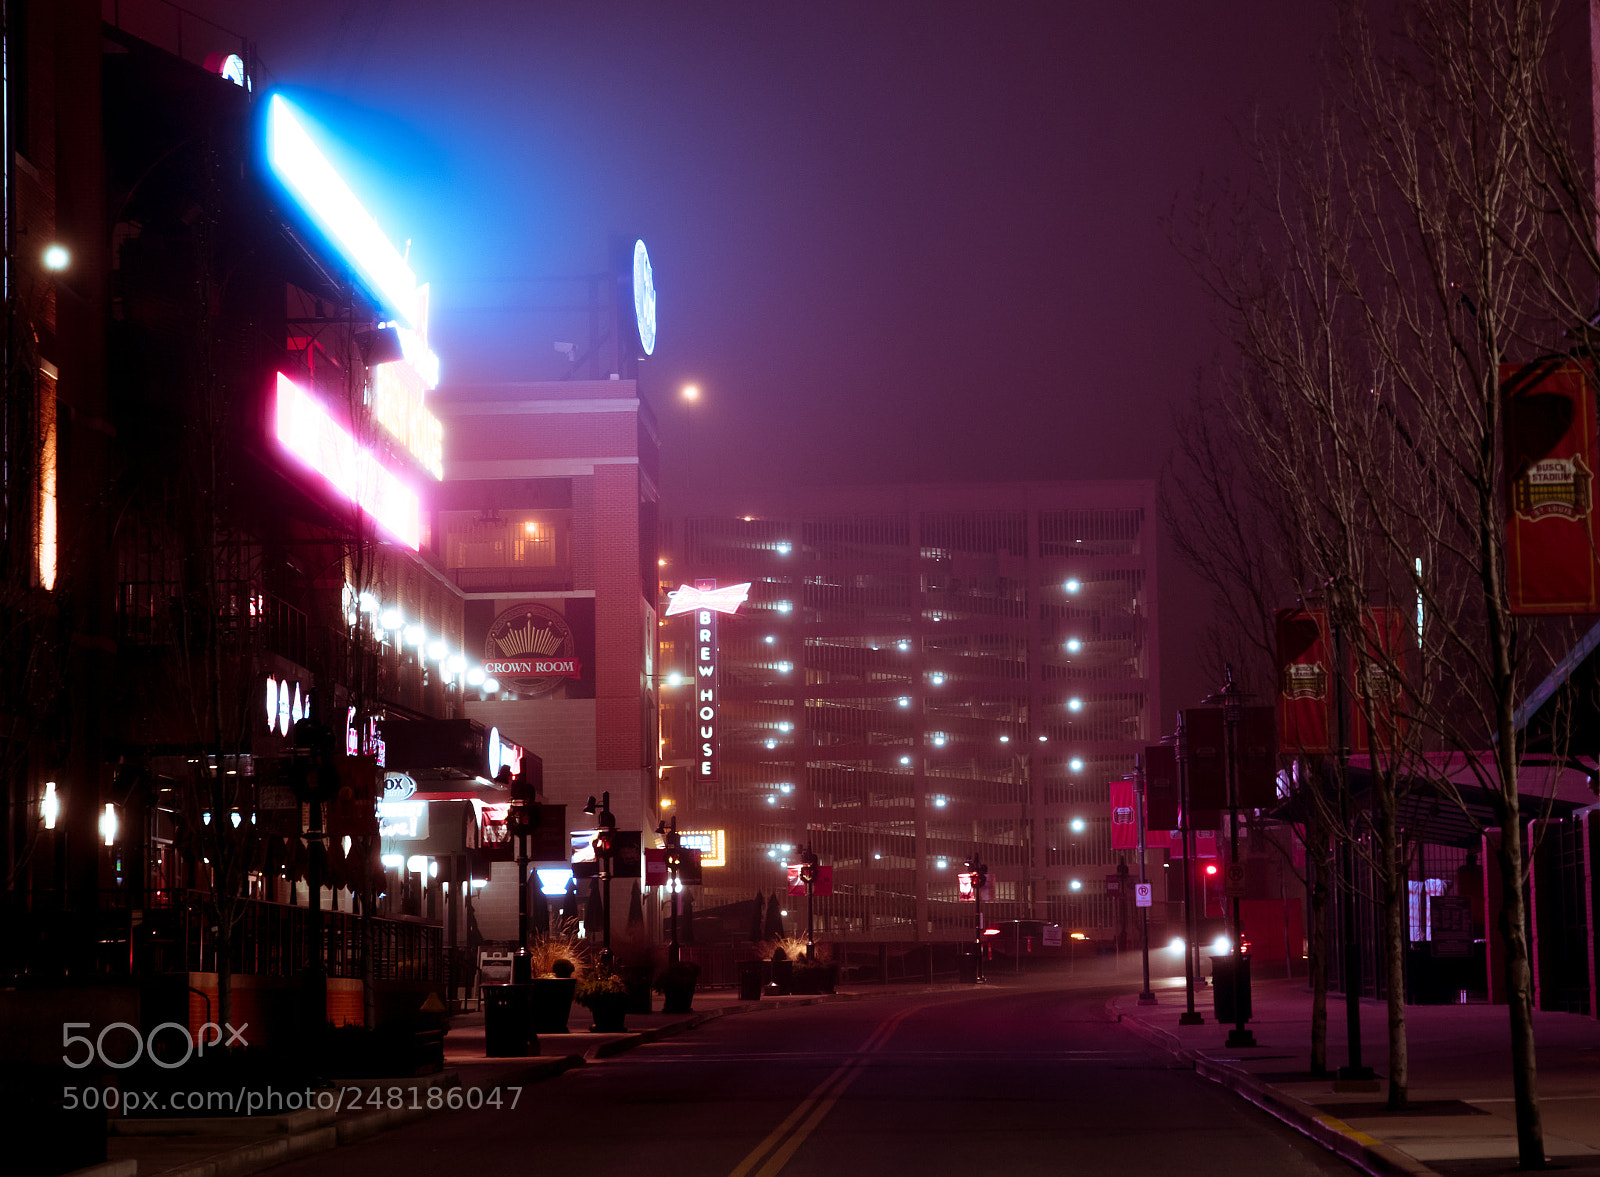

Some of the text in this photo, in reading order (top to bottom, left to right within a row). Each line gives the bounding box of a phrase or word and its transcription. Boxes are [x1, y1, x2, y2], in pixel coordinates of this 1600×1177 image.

[1536, 463, 1566, 472] BUSCH
[1532, 473, 1572, 481] STADIUM
[485, 661, 574, 673] CROWN ROOM
[699, 610, 714, 775] BREW HOUSE
[384, 778, 403, 790] OX
